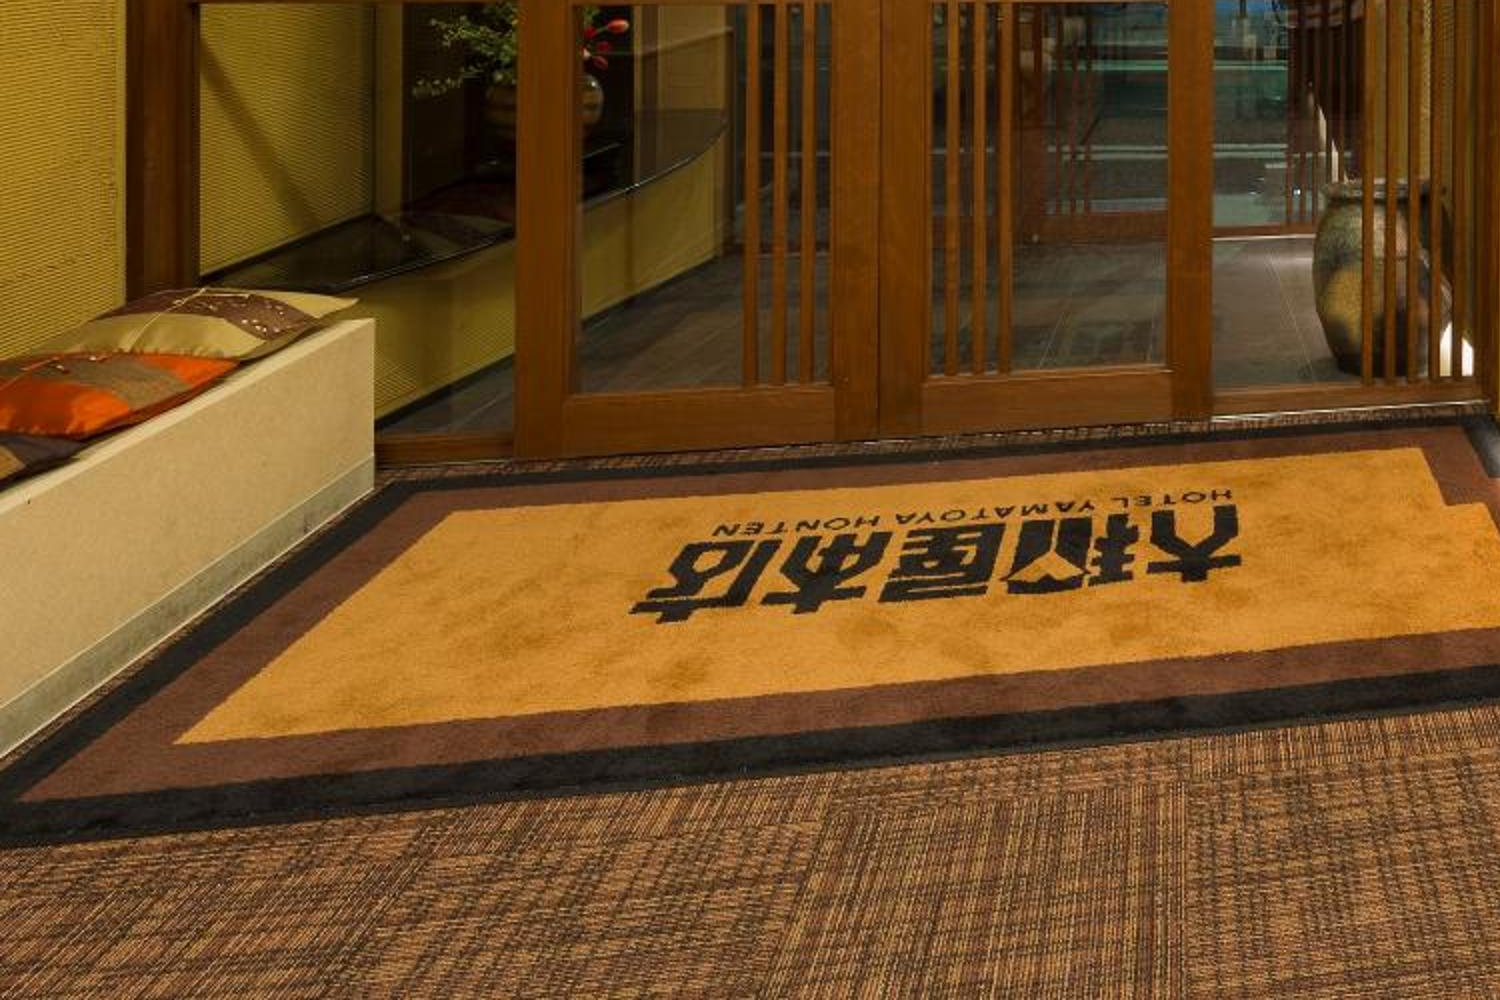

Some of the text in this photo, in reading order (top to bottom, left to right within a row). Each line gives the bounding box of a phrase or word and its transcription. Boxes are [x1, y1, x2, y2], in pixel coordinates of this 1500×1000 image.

[711, 489, 1233, 537] HOTEL YAMATOYA HONTEN
[628, 503, 1243, 625] 大和屋本店
